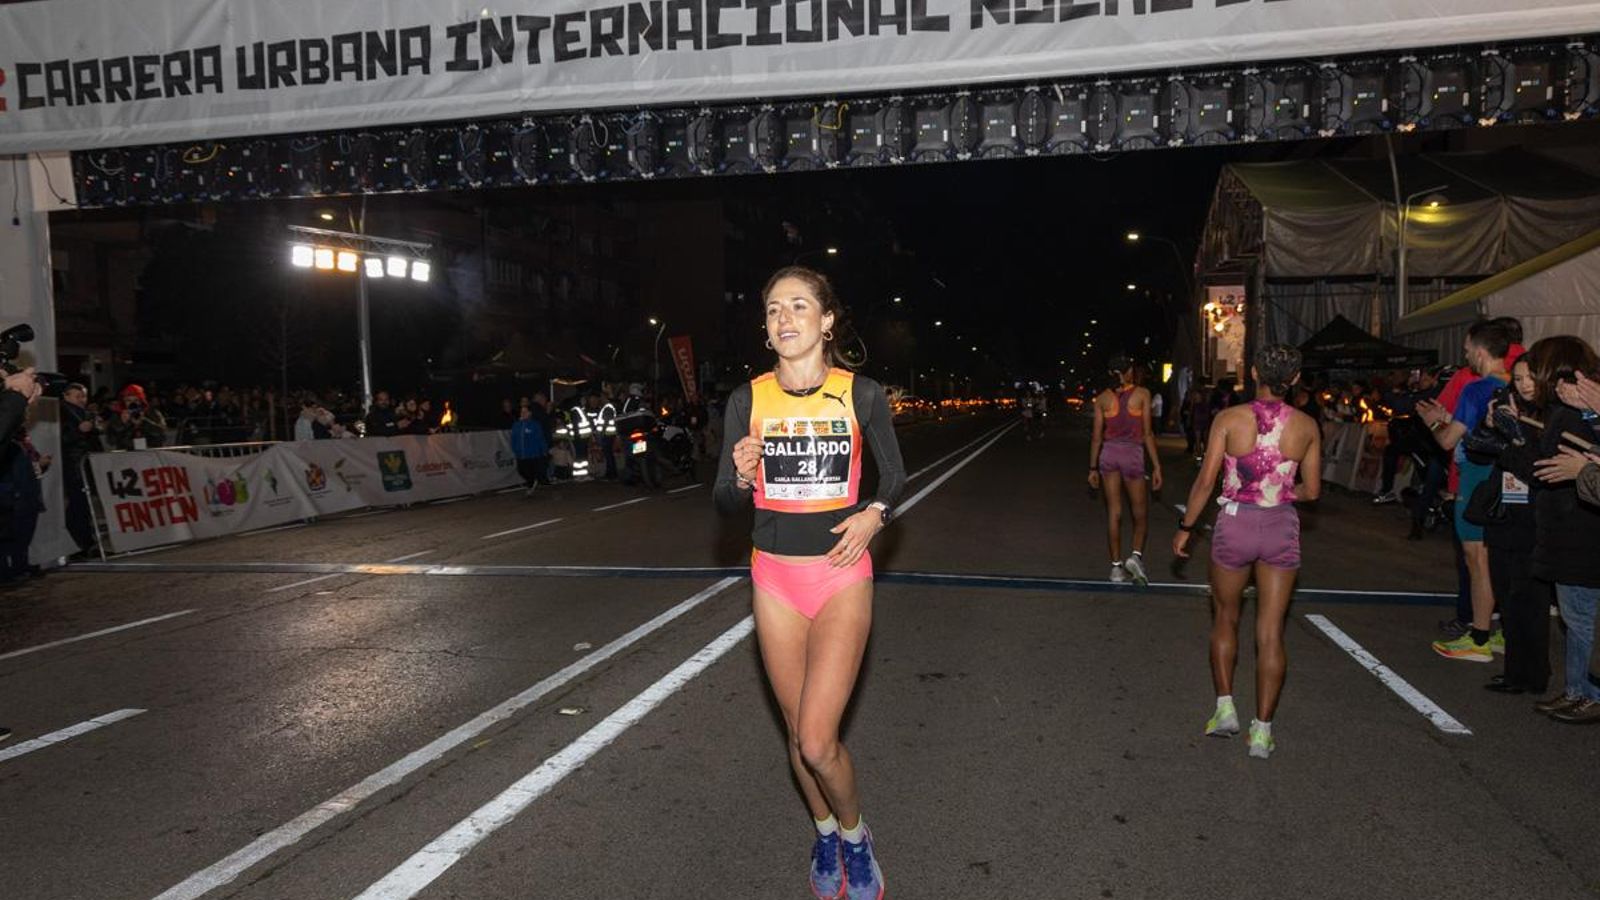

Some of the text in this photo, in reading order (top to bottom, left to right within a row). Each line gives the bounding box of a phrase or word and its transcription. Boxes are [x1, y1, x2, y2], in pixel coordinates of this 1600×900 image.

[15, 46, 224, 110] CARRERA
[235, 25, 431, 90] URBANA
[445, 0, 950, 72] INTERNACIONAL
[764, 441, 850, 456] GALLARDO
[797, 460, 817, 475] 28
[106, 466, 192, 498] 42 SAN
